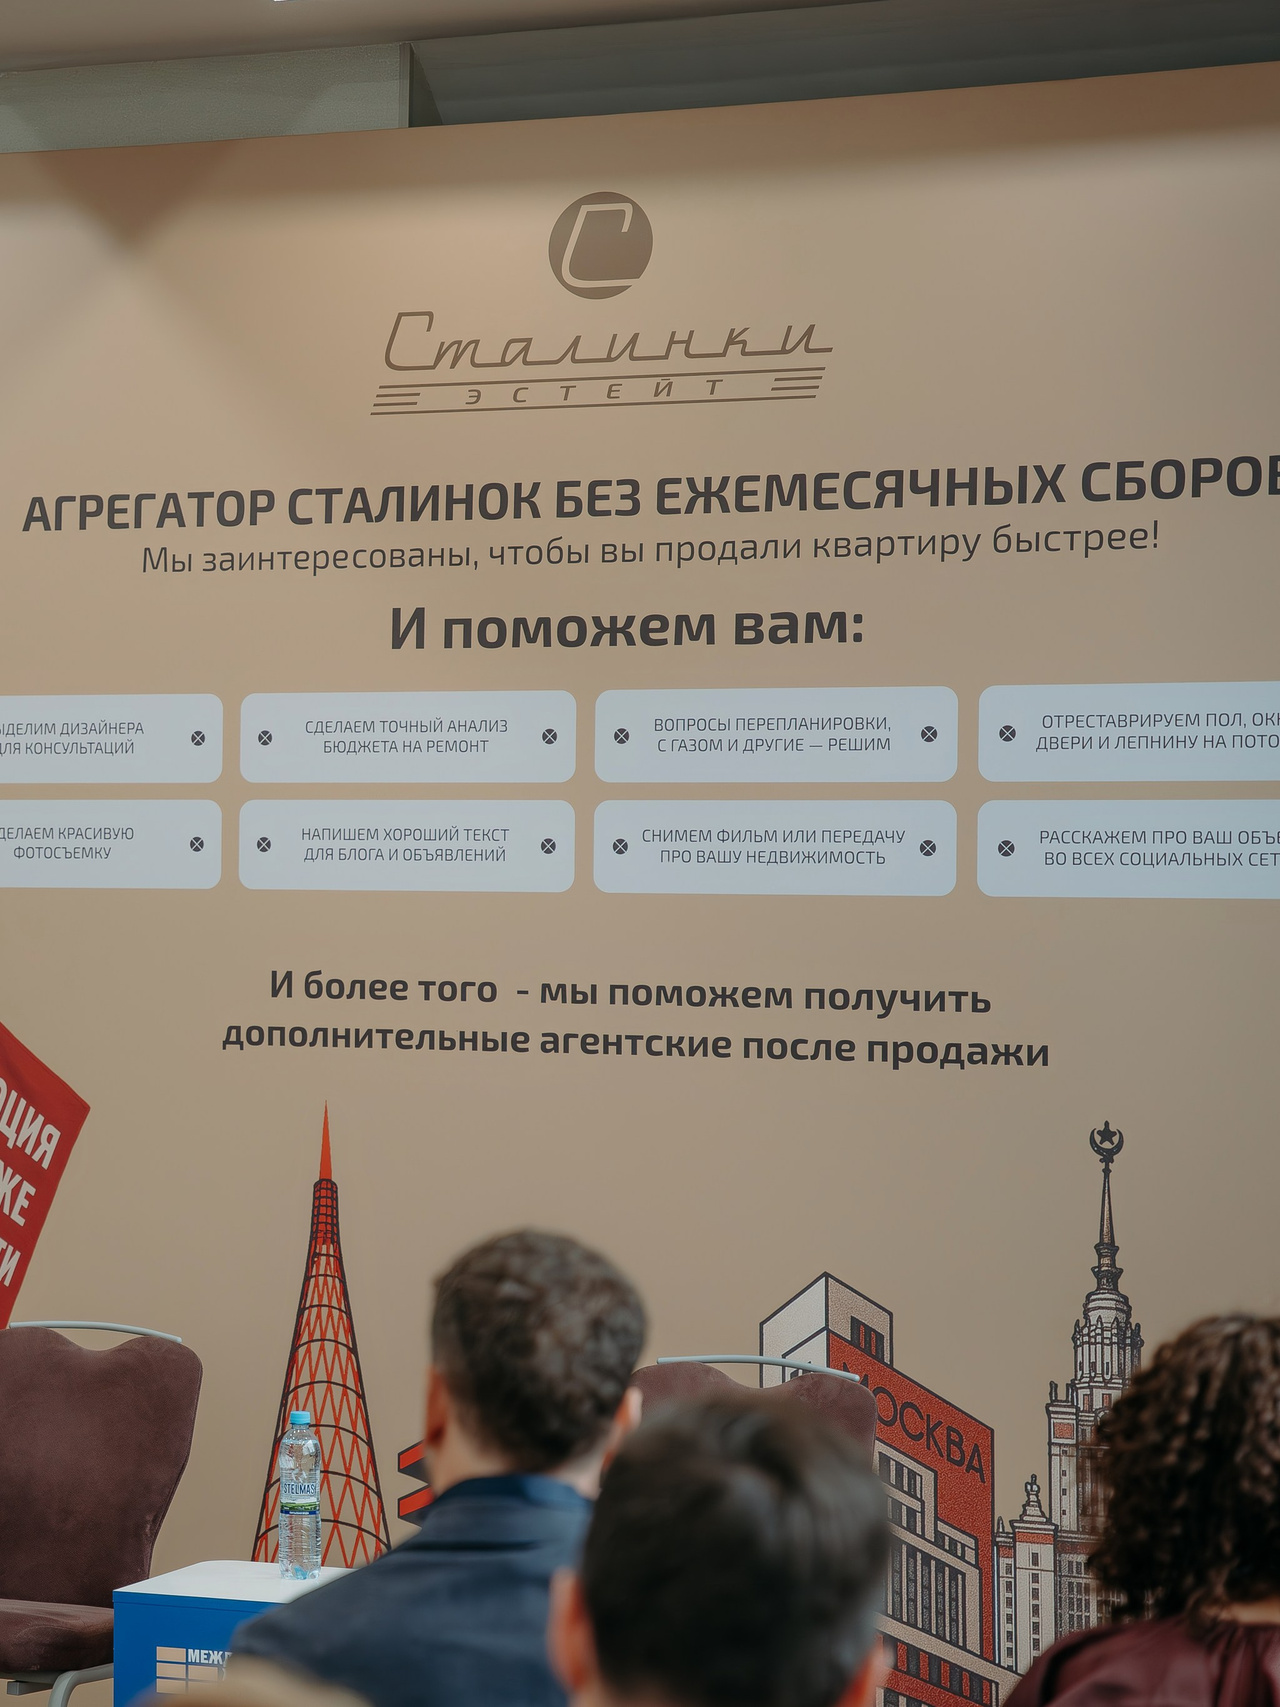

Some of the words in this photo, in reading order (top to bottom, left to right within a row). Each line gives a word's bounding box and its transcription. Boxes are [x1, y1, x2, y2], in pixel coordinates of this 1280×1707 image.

[385, 311, 833, 370] Сталинки
[465, 379, 723, 405] ЭСТЕЙТ
[22, 490, 275, 531] АГРЕГАТОР
[289, 482, 541, 525] СТАЛИНОК
[556, 479, 640, 518] БЕЗ
[657, 464, 1066, 515] ЕЖЕМЕСЯЧНЫХ
[143, 547, 191, 572] Мы
[203, 547, 477, 576] заинтересованы,
[490, 536, 588, 565] чтобы
[602, 543, 643, 563] вы
[656, 539, 800, 568] продали
[814, 534, 981, 564] квартиру
[994, 520, 1158, 558] быстрее!
[392, 607, 425, 649] И
[444, 614, 715, 648] поможем
[735, 612, 862, 645] вам:
[60, 720, 144, 737] ДИЗАЙНЕРА
[306, 721, 375, 735] СДЕЛАЕМ
[380, 717, 442, 733] ТОЧНЫЙ
[447, 720, 507, 732] АНАЛИЗ
[655, 718, 730, 731] ВОПРОСЫ
[736, 717, 890, 731] ПЕРЕПЛАНИРОВКИ,
[1043, 714, 1199, 728] ОТРЕСТАВРИРУЕМ
[1207, 713, 1246, 728] ПОЛ,
[26, 739, 133, 756] КОНСУЛЬТАЦИЙ
[324, 741, 398, 755] БЮДЖЕТА
[403, 741, 422, 752] НА
[427, 740, 489, 752] РЕМОНТ
[658, 739, 666, 752] С
[672, 739, 722, 751] ГАЗОМ
[729, 739, 737, 751] И
[743, 739, 804, 754] ДРУГИЕ
[829, 738, 890, 751] РЕШИМ
[1036, 736, 1092, 752] ДВЕРИ
[1099, 736, 1109, 749] И
[1115, 736, 1198, 749] ЛЕПНИНУ
[1204, 735, 1226, 748] НА
[59, 828, 133, 840] КРАСИВУЮ
[302, 828, 378, 840] НАПИШЕМ
[384, 826, 458, 841] ХОРОШИЙ
[464, 829, 509, 841] ТЕКСТ
[643, 830, 711, 842] СНИМЕМ
[717, 829, 777, 843] ФИЛЬМ
[783, 830, 816, 843] ИЛИ
[822, 830, 905, 845] ПЕРЕДАЧУ
[1040, 831, 1146, 844] РАССКАЖЕМ
[1153, 831, 1186, 844] ПРО
[1193, 831, 1231, 844] ВАШ
[14, 846, 111, 859] ФОТОСЪЕМКУ
[304, 848, 333, 862] ДЛЯ
[339, 848, 384, 860] БЛОГА
[389, 849, 398, 860] И
[403, 846, 505, 861] ОБЪЯВЛЕНИЙ
[661, 850, 691, 863] ПРО
[697, 850, 742, 863] ВАШУ
[747, 851, 885, 866] НЕДВИЖИМОСТЬ
[1045, 852, 1066, 865] ВО
[1073, 852, 1114, 865] ВСЕХ
[1120, 852, 1243, 868] СОЦИАЛЬНЫХ
[272, 971, 292, 998] И
[305, 970, 408, 1000] более
[418, 981, 497, 1002] того
[541, 983, 597, 1004] мы
[610, 985, 792, 1008] поможем
[806, 988, 991, 1019] получить
[223, 1026, 529, 1052] дополнительные
[541, 1033, 731, 1058] агентские
[744, 1038, 855, 1061] после
[868, 1041, 1048, 1070] продажи
